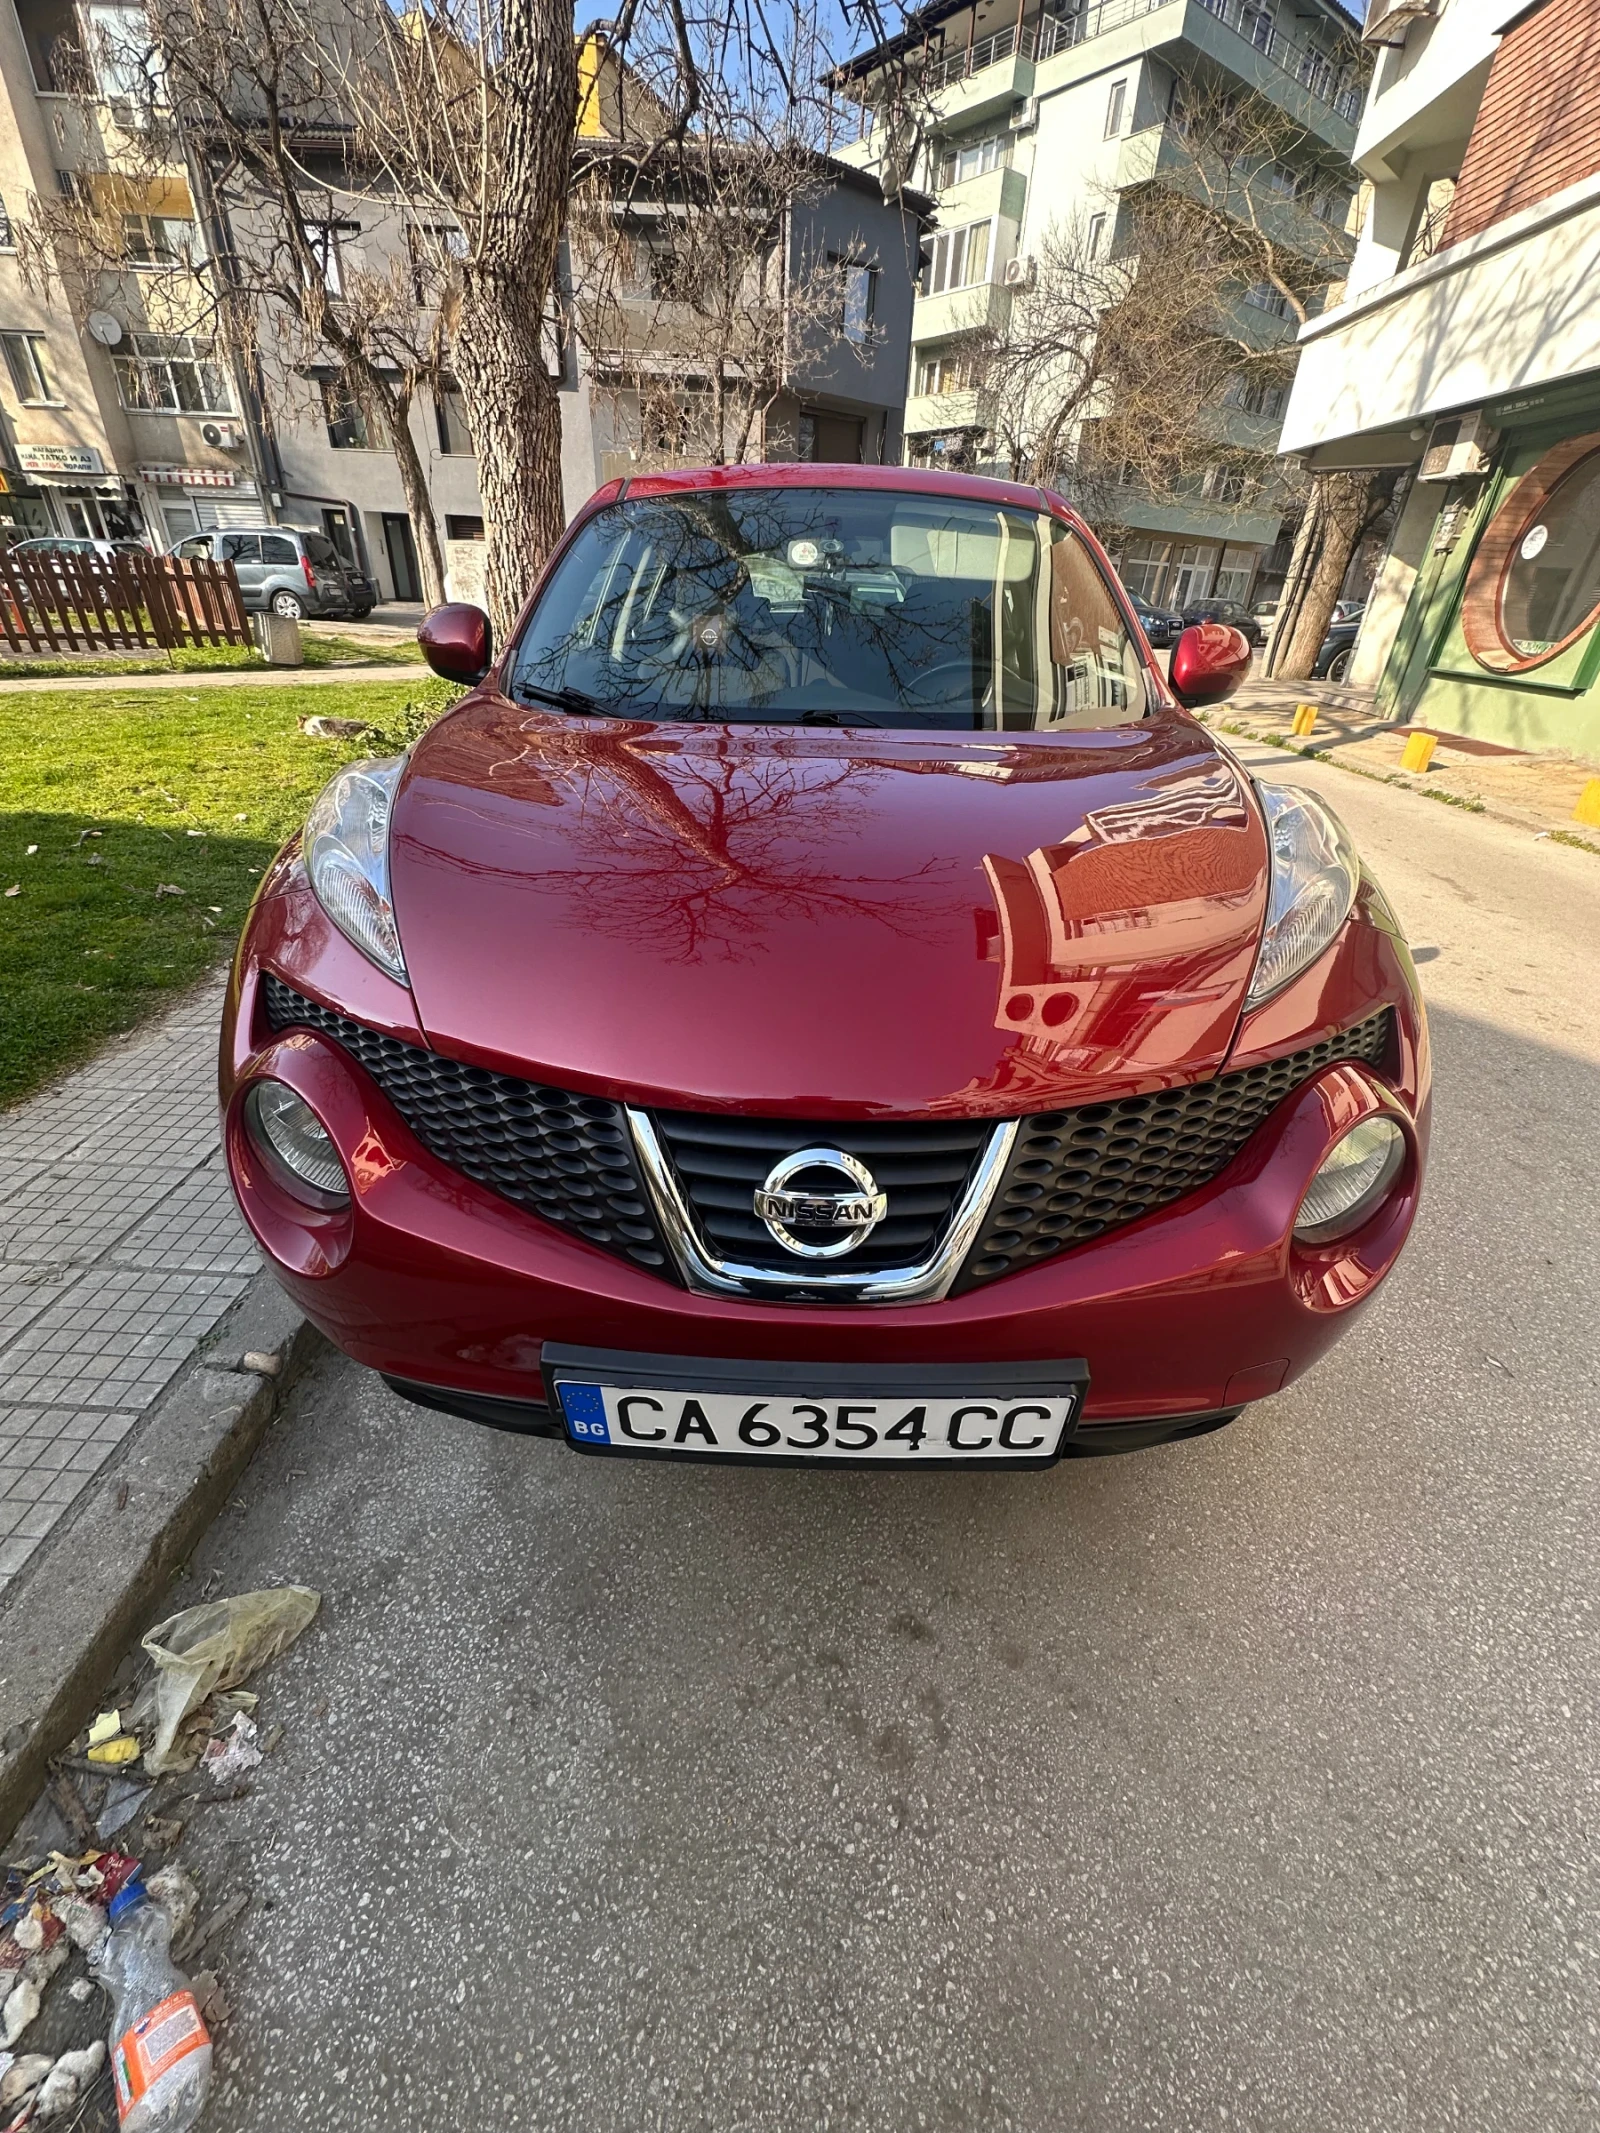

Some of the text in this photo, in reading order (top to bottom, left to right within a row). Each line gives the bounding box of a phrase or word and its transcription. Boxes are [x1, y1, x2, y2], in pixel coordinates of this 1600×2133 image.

[63, 462, 92, 470] ЧОРАПИ
[767, 1199, 874, 1221] NISSAN
[574, 1420, 605, 1437] BG
[617, 1395, 1052, 1450] CA 6354 CC
